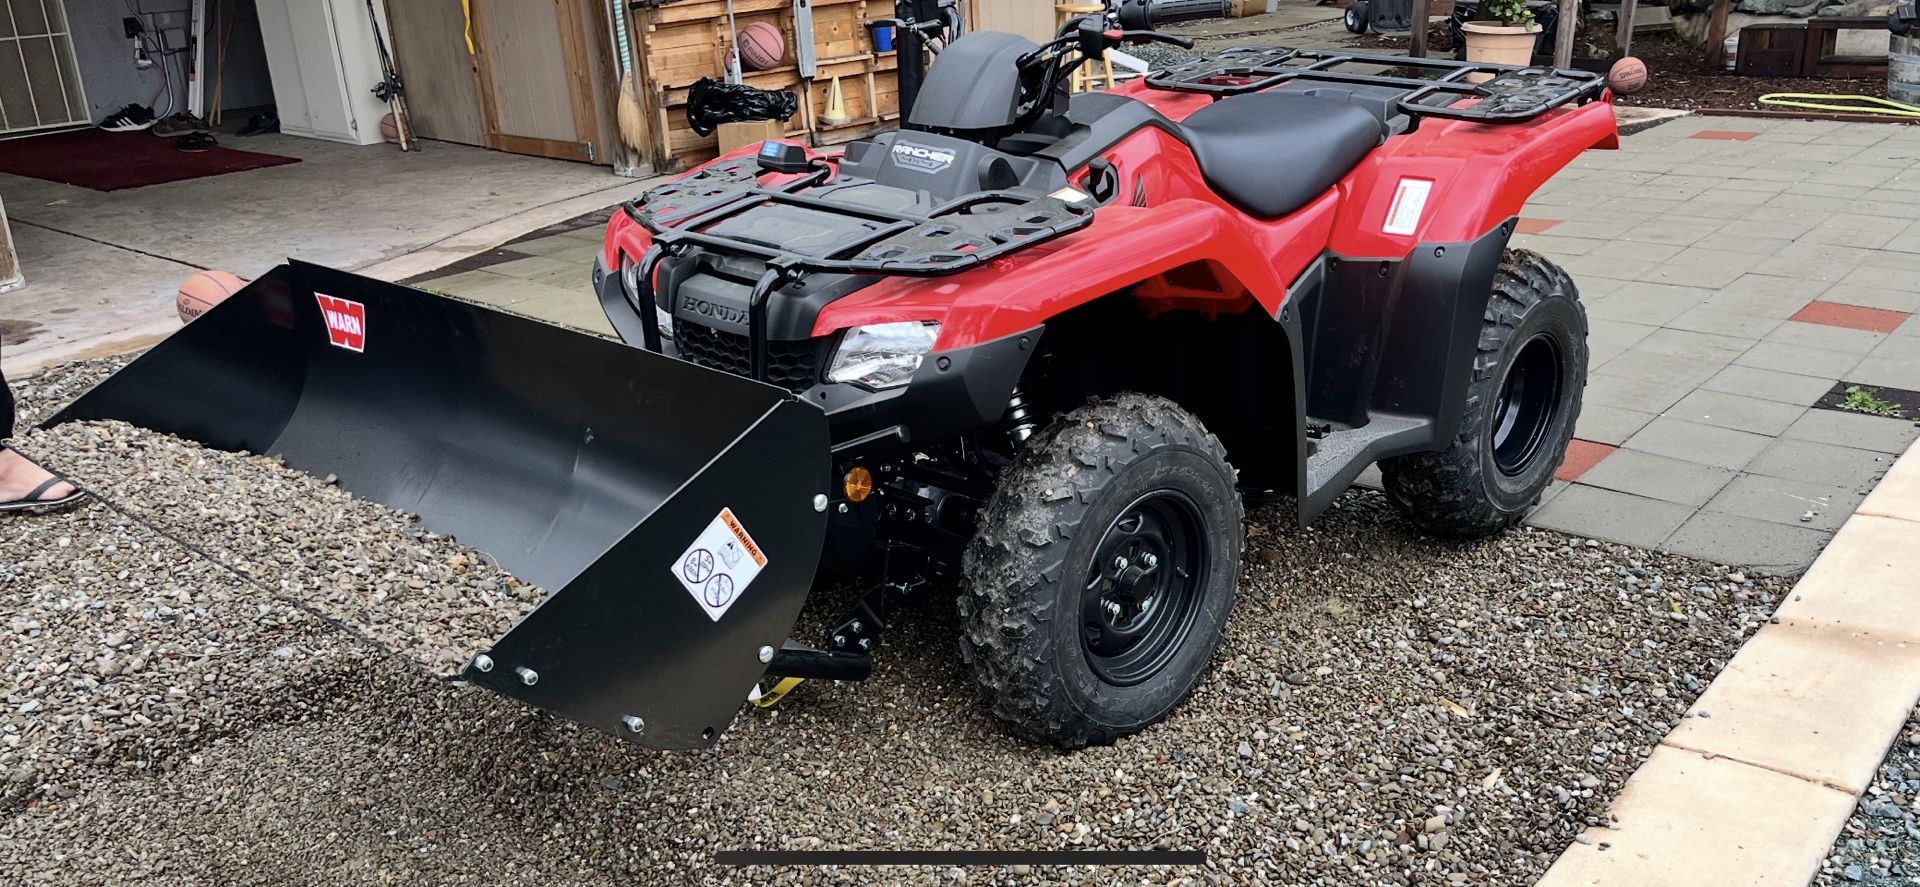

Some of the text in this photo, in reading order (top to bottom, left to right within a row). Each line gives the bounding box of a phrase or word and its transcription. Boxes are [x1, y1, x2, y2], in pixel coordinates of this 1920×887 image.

[892, 145, 955, 164] RANCHER
[326, 309, 362, 336] WARN
[682, 296, 749, 325] HONDA
[730, 520, 757, 557] WARNING
